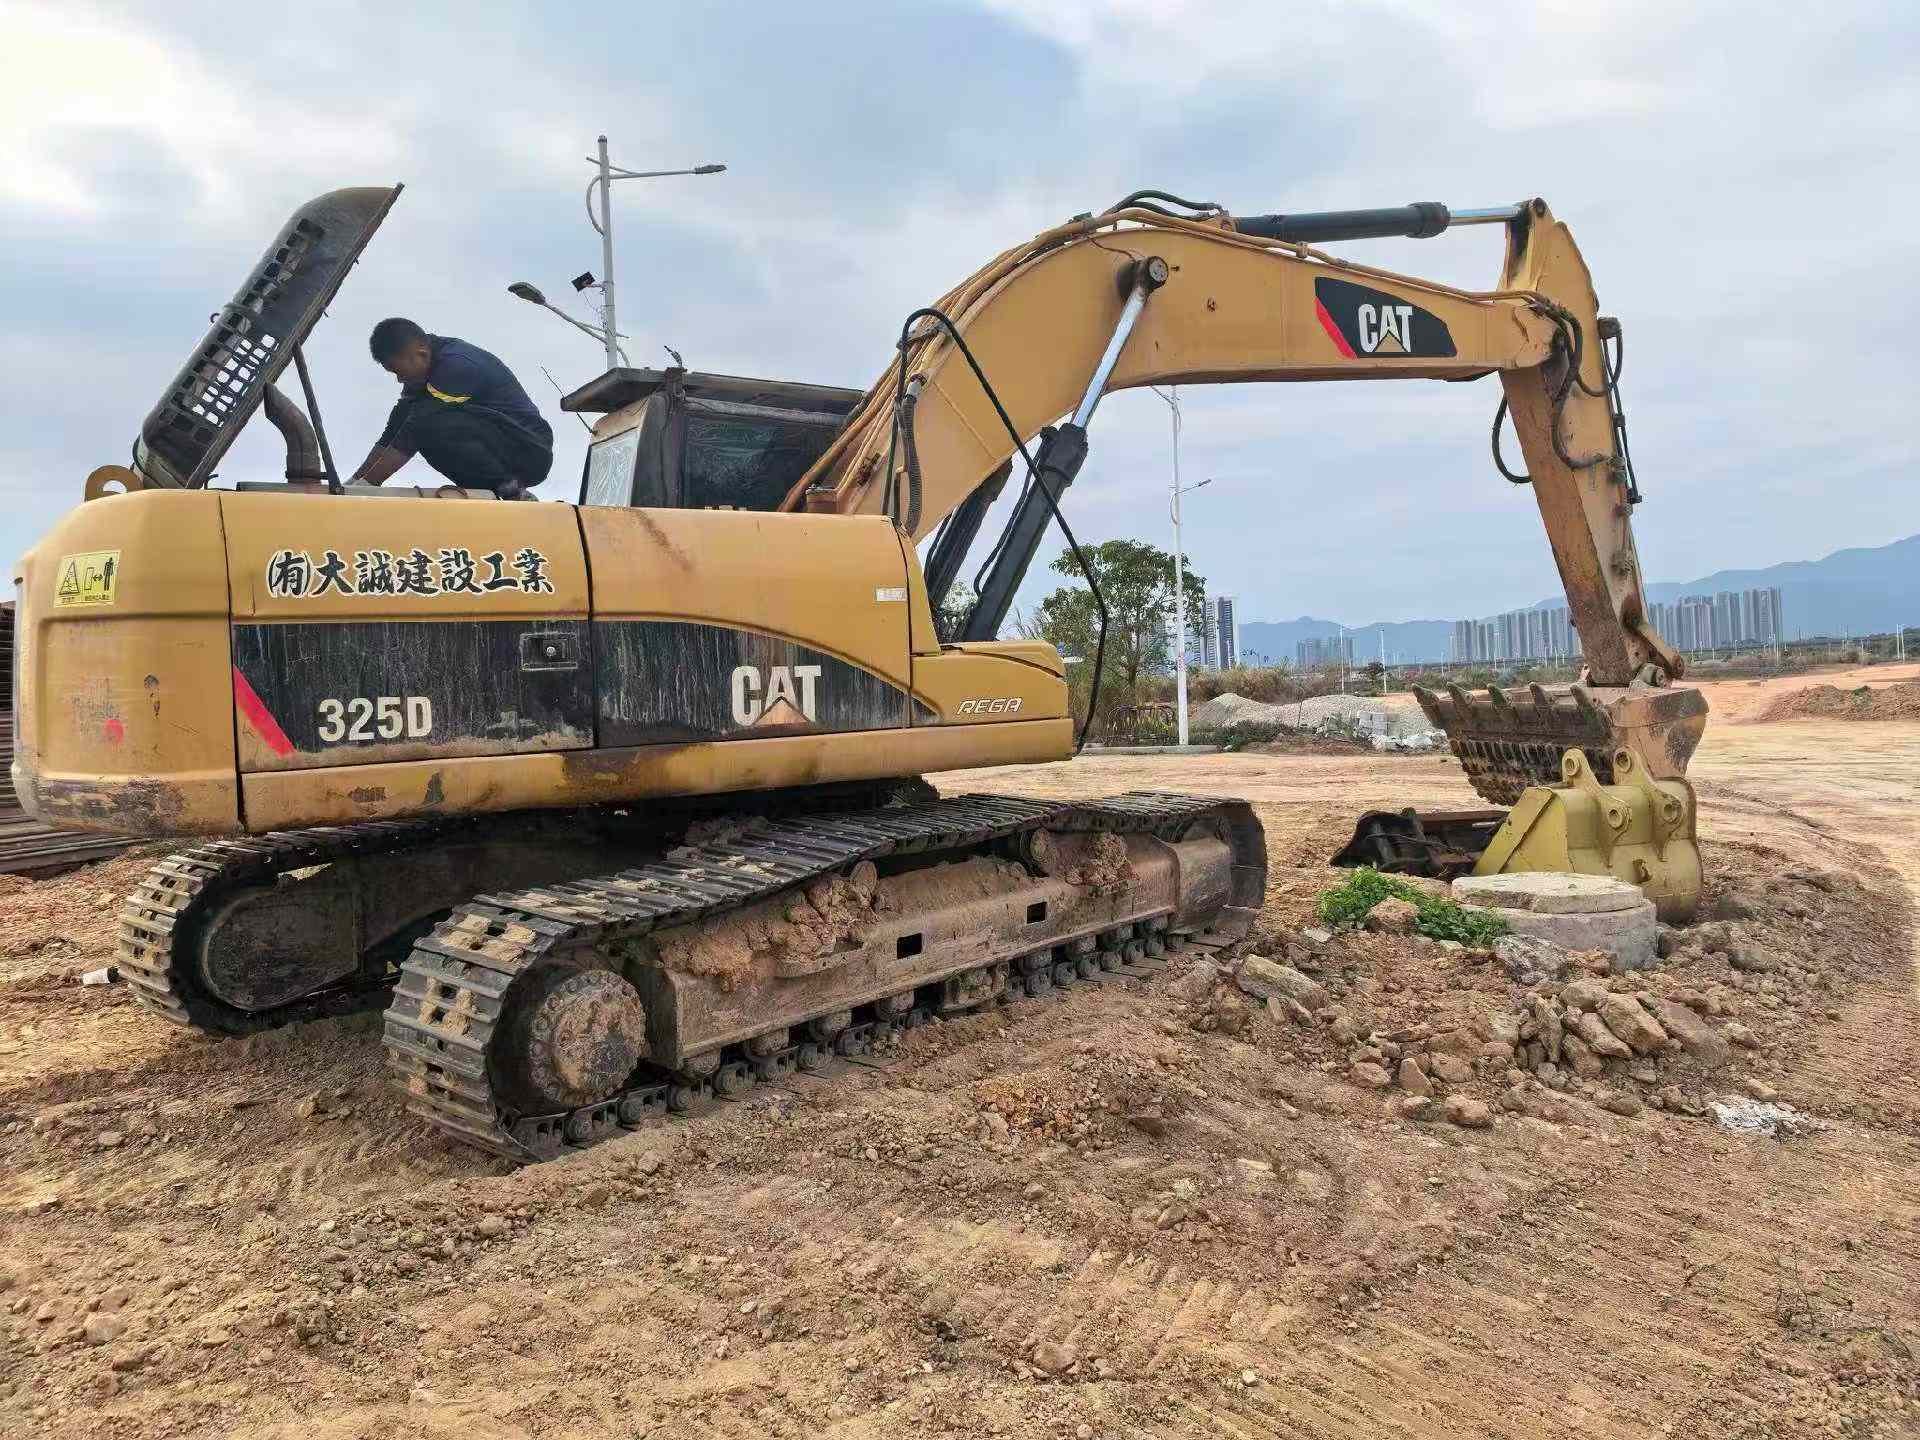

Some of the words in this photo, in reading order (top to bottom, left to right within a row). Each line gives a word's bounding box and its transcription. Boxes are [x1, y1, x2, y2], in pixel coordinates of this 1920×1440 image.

[1358, 304, 1412, 353] CAT
[317, 696, 433, 742] 325D
[732, 665, 822, 727] CAT
[956, 697, 1022, 715] REGA
